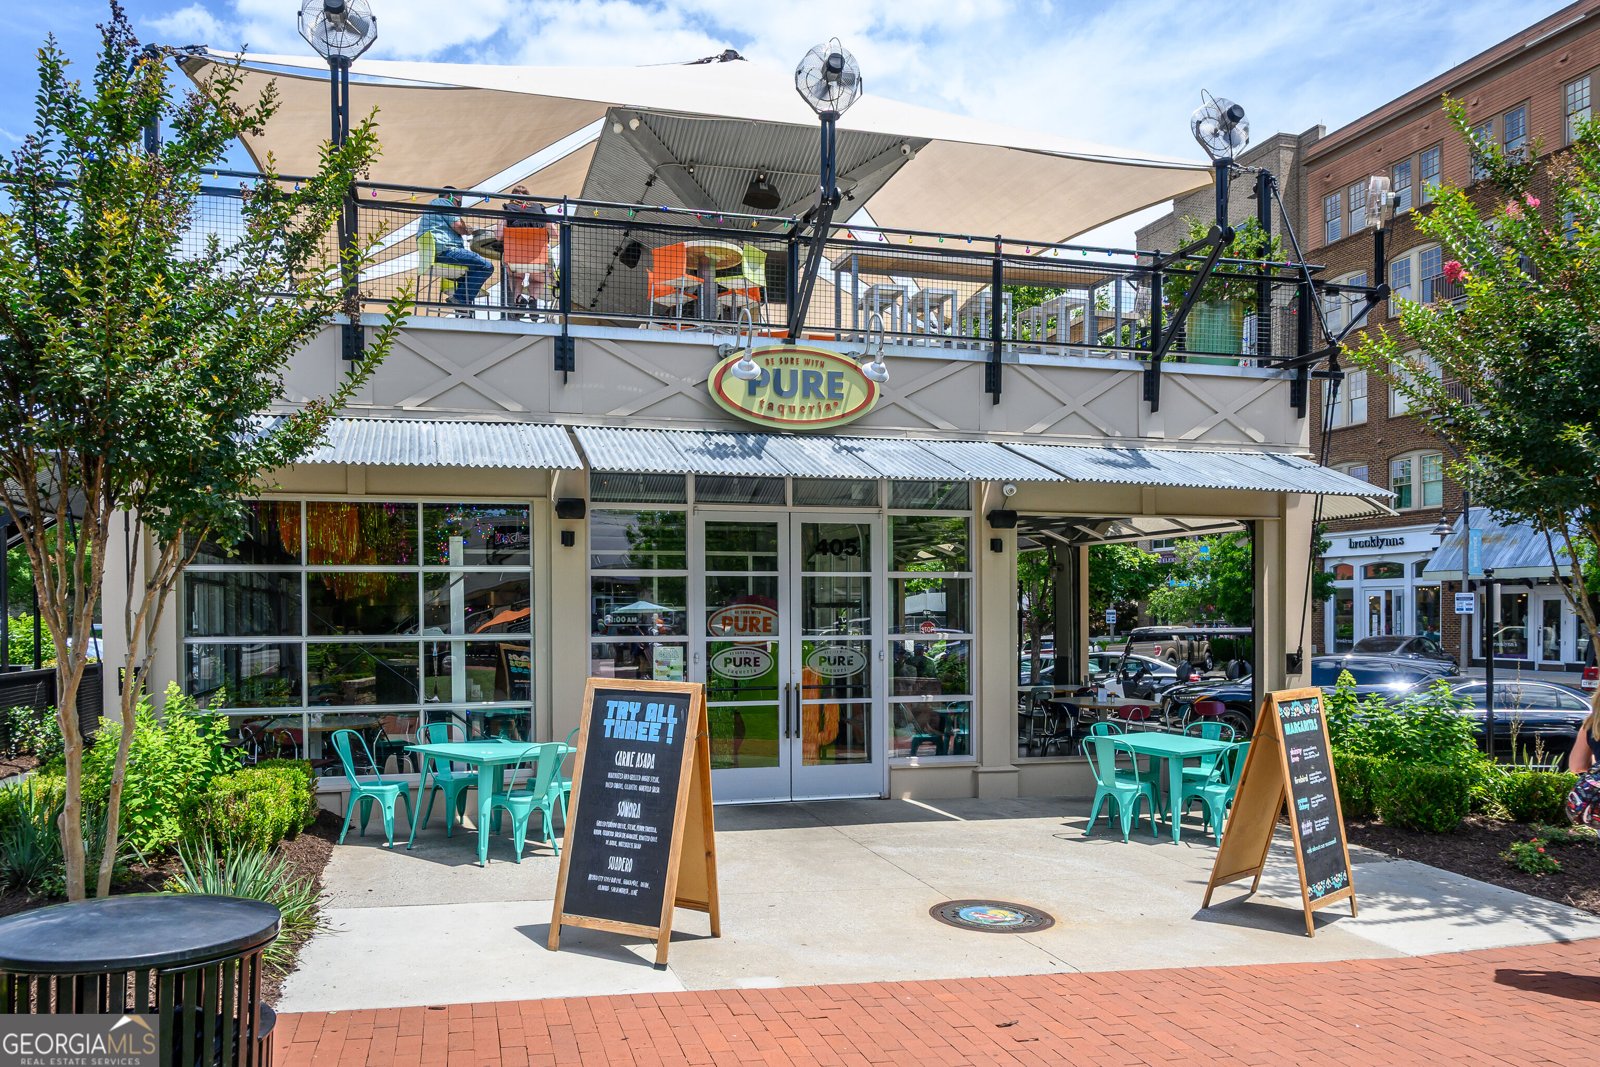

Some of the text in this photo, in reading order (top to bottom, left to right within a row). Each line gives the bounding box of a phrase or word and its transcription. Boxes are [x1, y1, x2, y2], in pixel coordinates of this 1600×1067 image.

[779, 357, 800, 365] SURE
[803, 358, 825, 368] WITH
[747, 367, 844, 400] PURE
[815, 538, 857, 556] 405
[721, 616, 772, 633] PURE
[723, 657, 760, 667] PURE
[818, 655, 854, 666] PURE
[605, 700, 678, 724] TRY ALL
[614, 750, 655, 769] CARNE ASADA
[616, 801, 641, 818] SONORA
